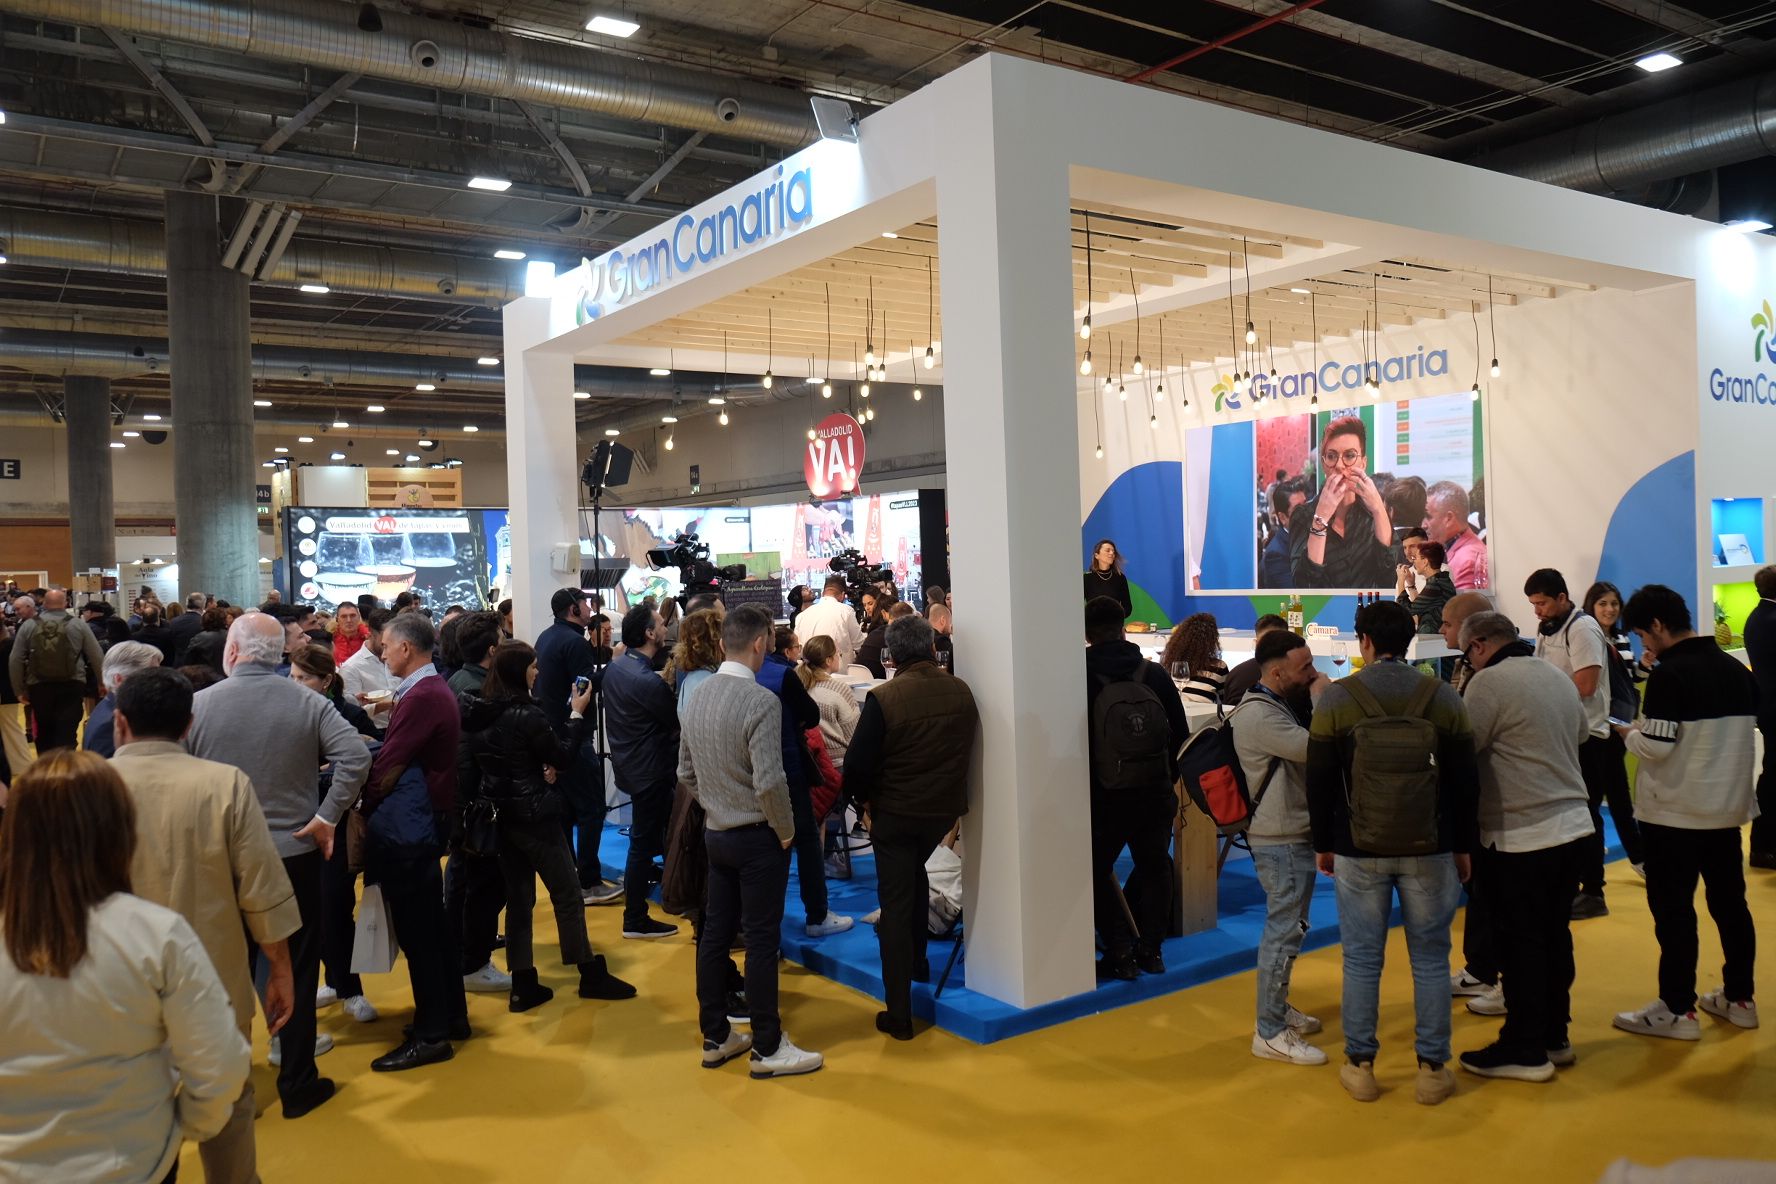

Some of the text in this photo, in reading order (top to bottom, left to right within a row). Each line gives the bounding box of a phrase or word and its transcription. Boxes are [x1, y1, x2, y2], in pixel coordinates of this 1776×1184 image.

[606, 164, 813, 303] GranCanaria
[1249, 345, 1448, 399] GranCanaria
[808, 436, 856, 485] VA!
